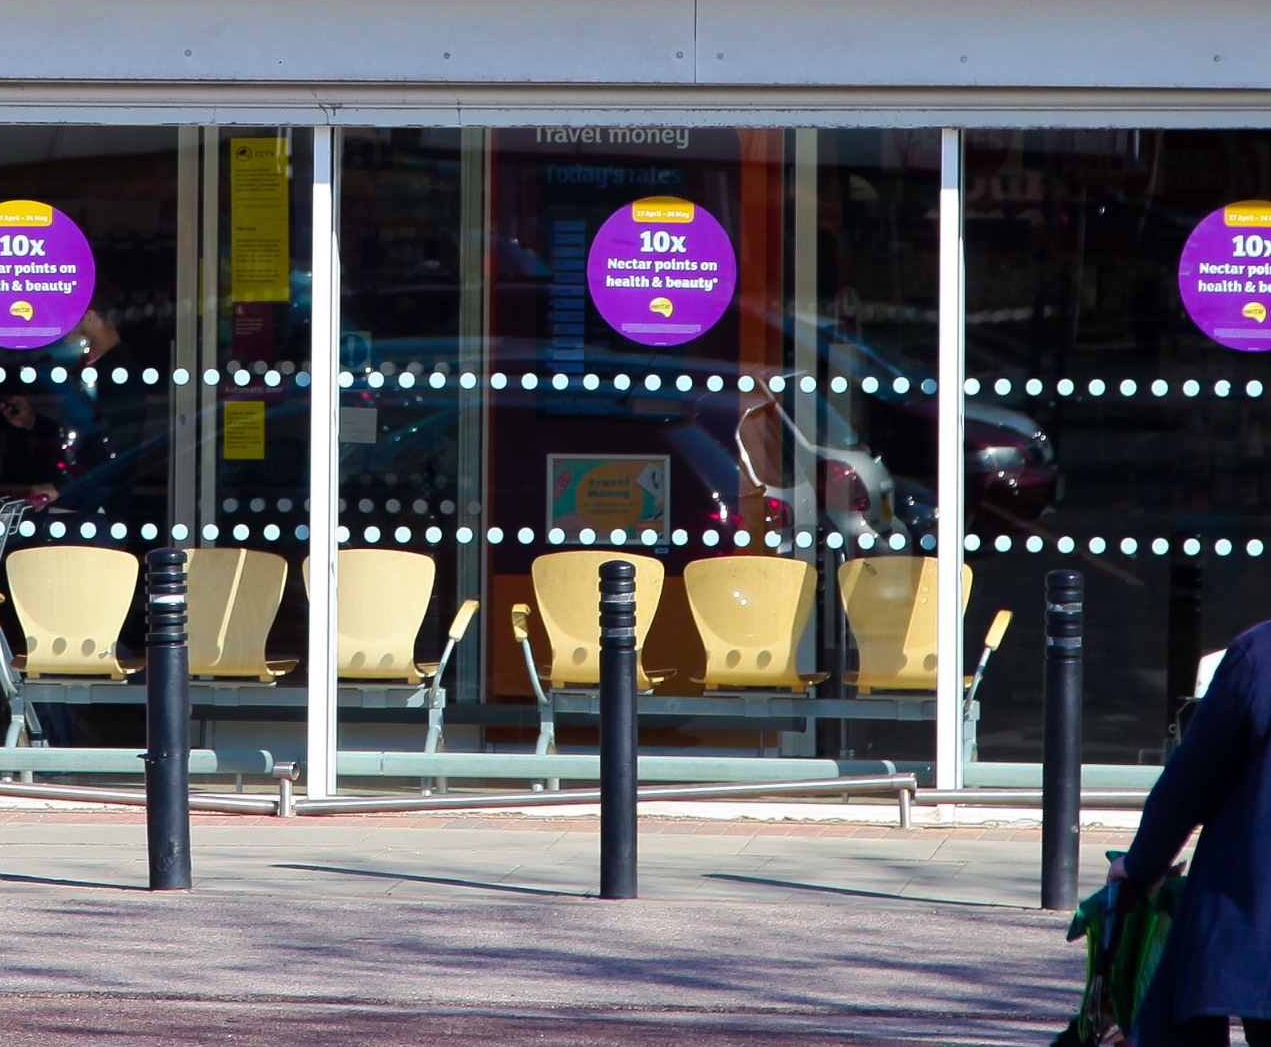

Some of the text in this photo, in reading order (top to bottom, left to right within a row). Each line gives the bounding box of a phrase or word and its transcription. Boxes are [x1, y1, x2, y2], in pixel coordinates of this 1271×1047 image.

[608, 127, 690, 149] money
[639, 230, 687, 253] 10x
[13, 261, 58, 277] points
[59, 264, 77, 274] on
[607, 257, 718, 273] Nectar points on
[1199, 262, 1246, 275] Nectar
[11, 279, 23, 292] &
[605, 274, 650, 288] health
[651, 276, 663, 288] &
[1198, 279, 1243, 293] health
[1244, 280, 1256, 293] &
